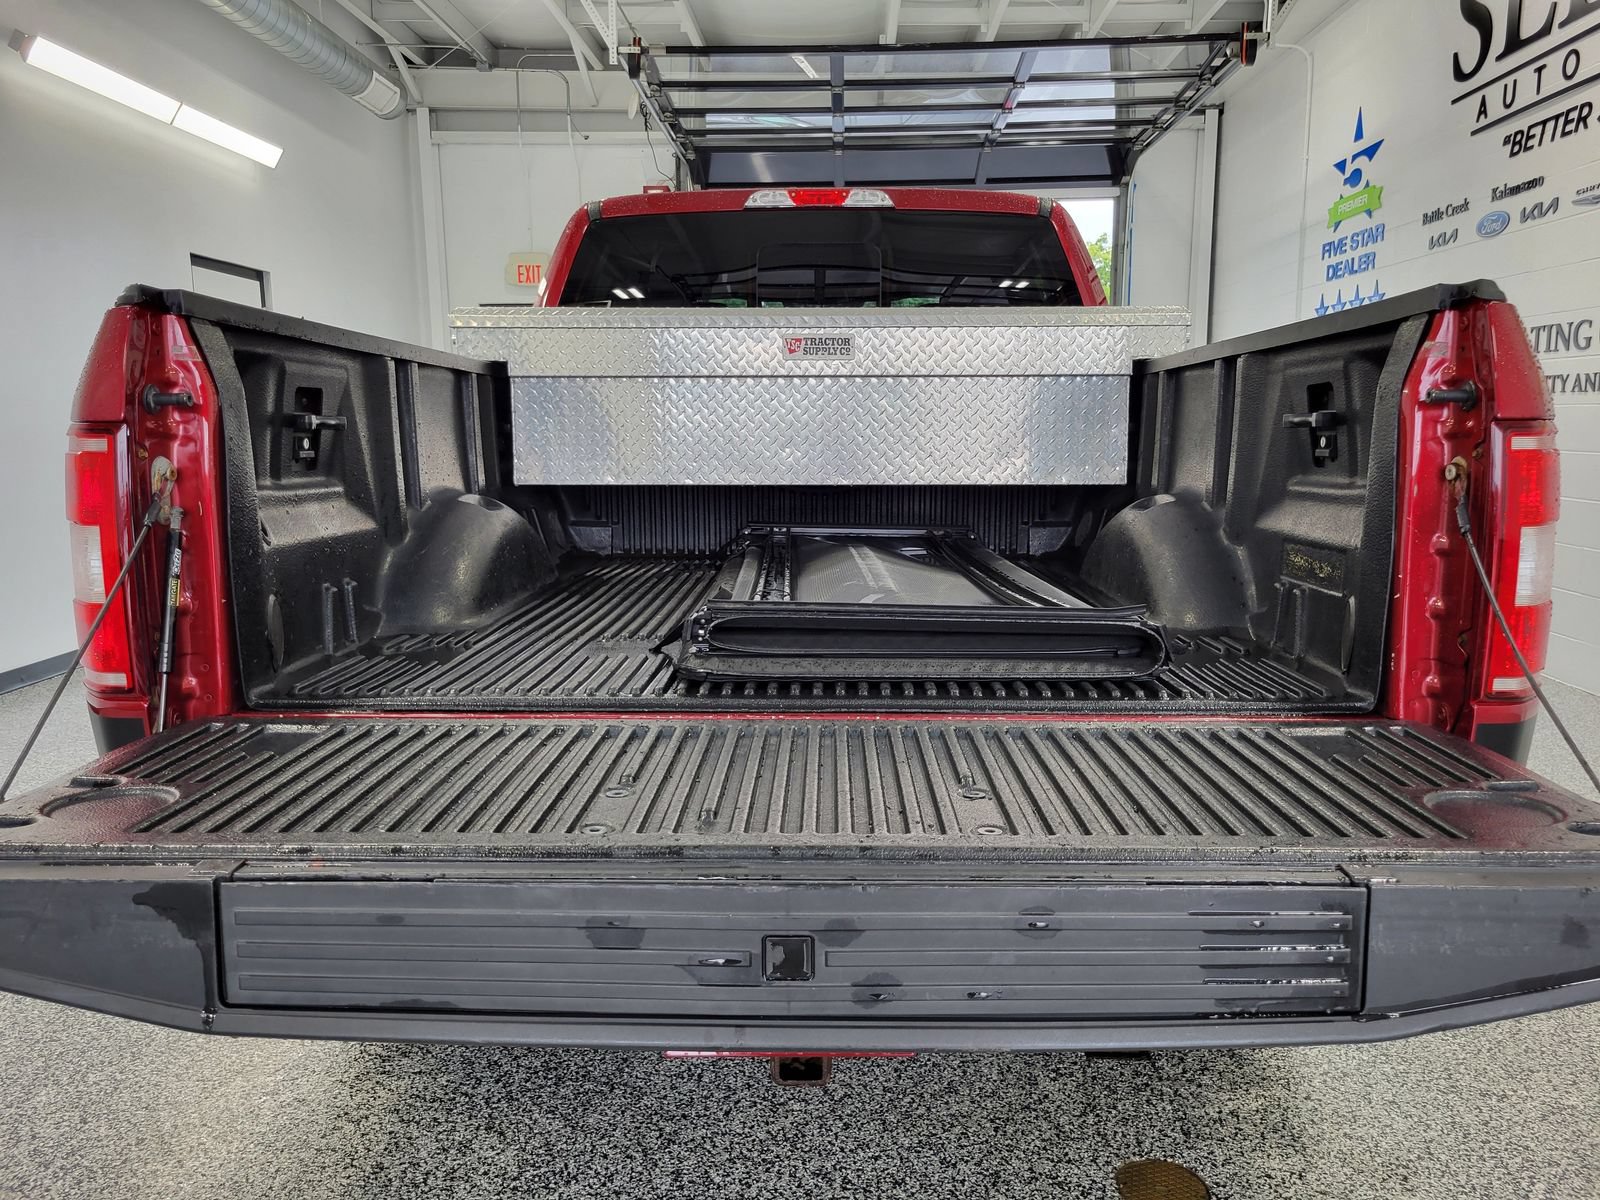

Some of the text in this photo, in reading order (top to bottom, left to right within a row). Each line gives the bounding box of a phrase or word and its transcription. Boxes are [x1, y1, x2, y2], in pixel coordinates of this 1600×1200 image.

[1476, 48, 1580, 124] AUTO
[1490, 175, 1545, 202] Kalamazoo
[1337, 194, 1368, 215] PREMIER
[1422, 197, 1470, 226] Battle Creek
[1428, 196, 1560, 251] KIA Ford KIA
[1321, 222, 1386, 261] FIVE STAR
[517, 264, 541, 284] EXIT
[1326, 250, 1377, 282] DEALER
[786, 338, 801, 352] TSC
[803, 337, 851, 347] TRACTOR
[1530, 319, 1593, 353] TING
[803, 347, 838, 356] SUPPLY
[1570, 371, 1600, 393] AN
